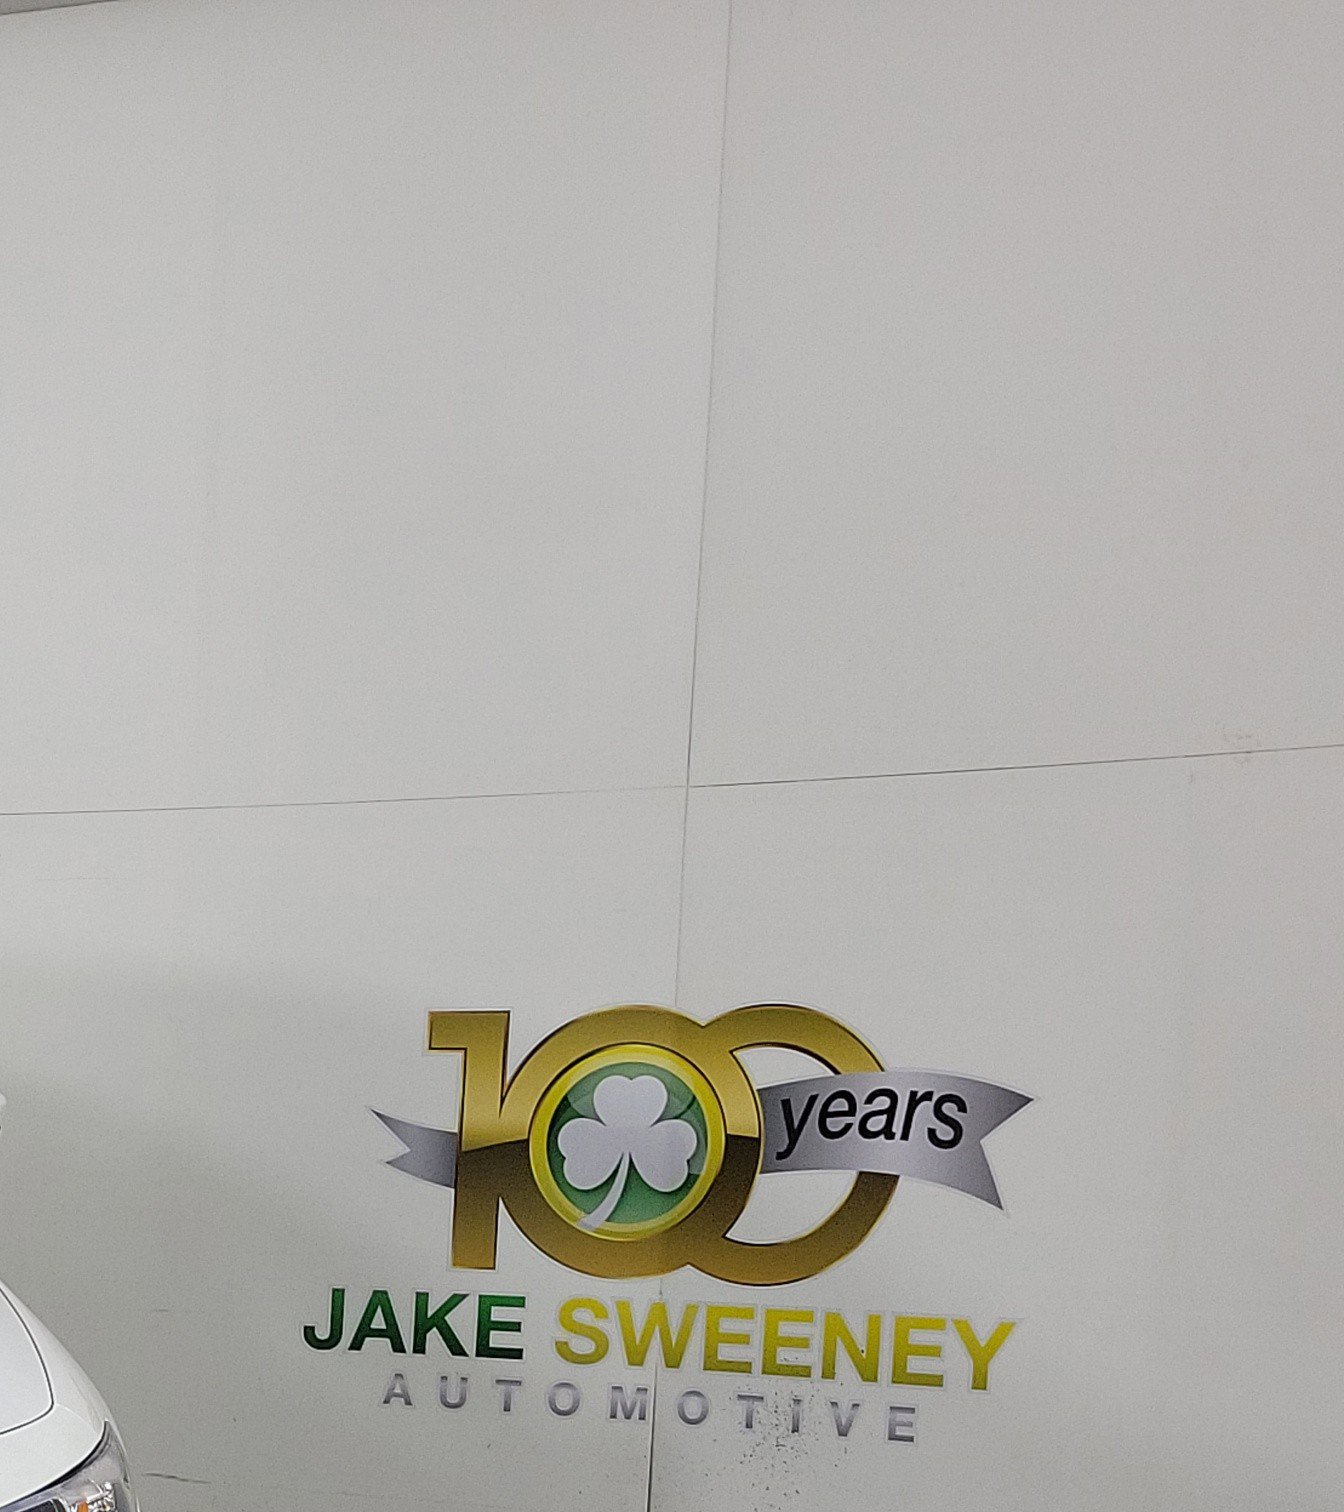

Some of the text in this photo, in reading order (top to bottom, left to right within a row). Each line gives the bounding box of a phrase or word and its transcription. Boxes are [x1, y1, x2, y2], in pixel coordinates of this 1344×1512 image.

[428, 1004, 967, 1286] 100 years
[303, 1288, 1016, 1391] JAKE SWEENEY
[382, 1373, 916, 1443] AUTOMOTIVE
